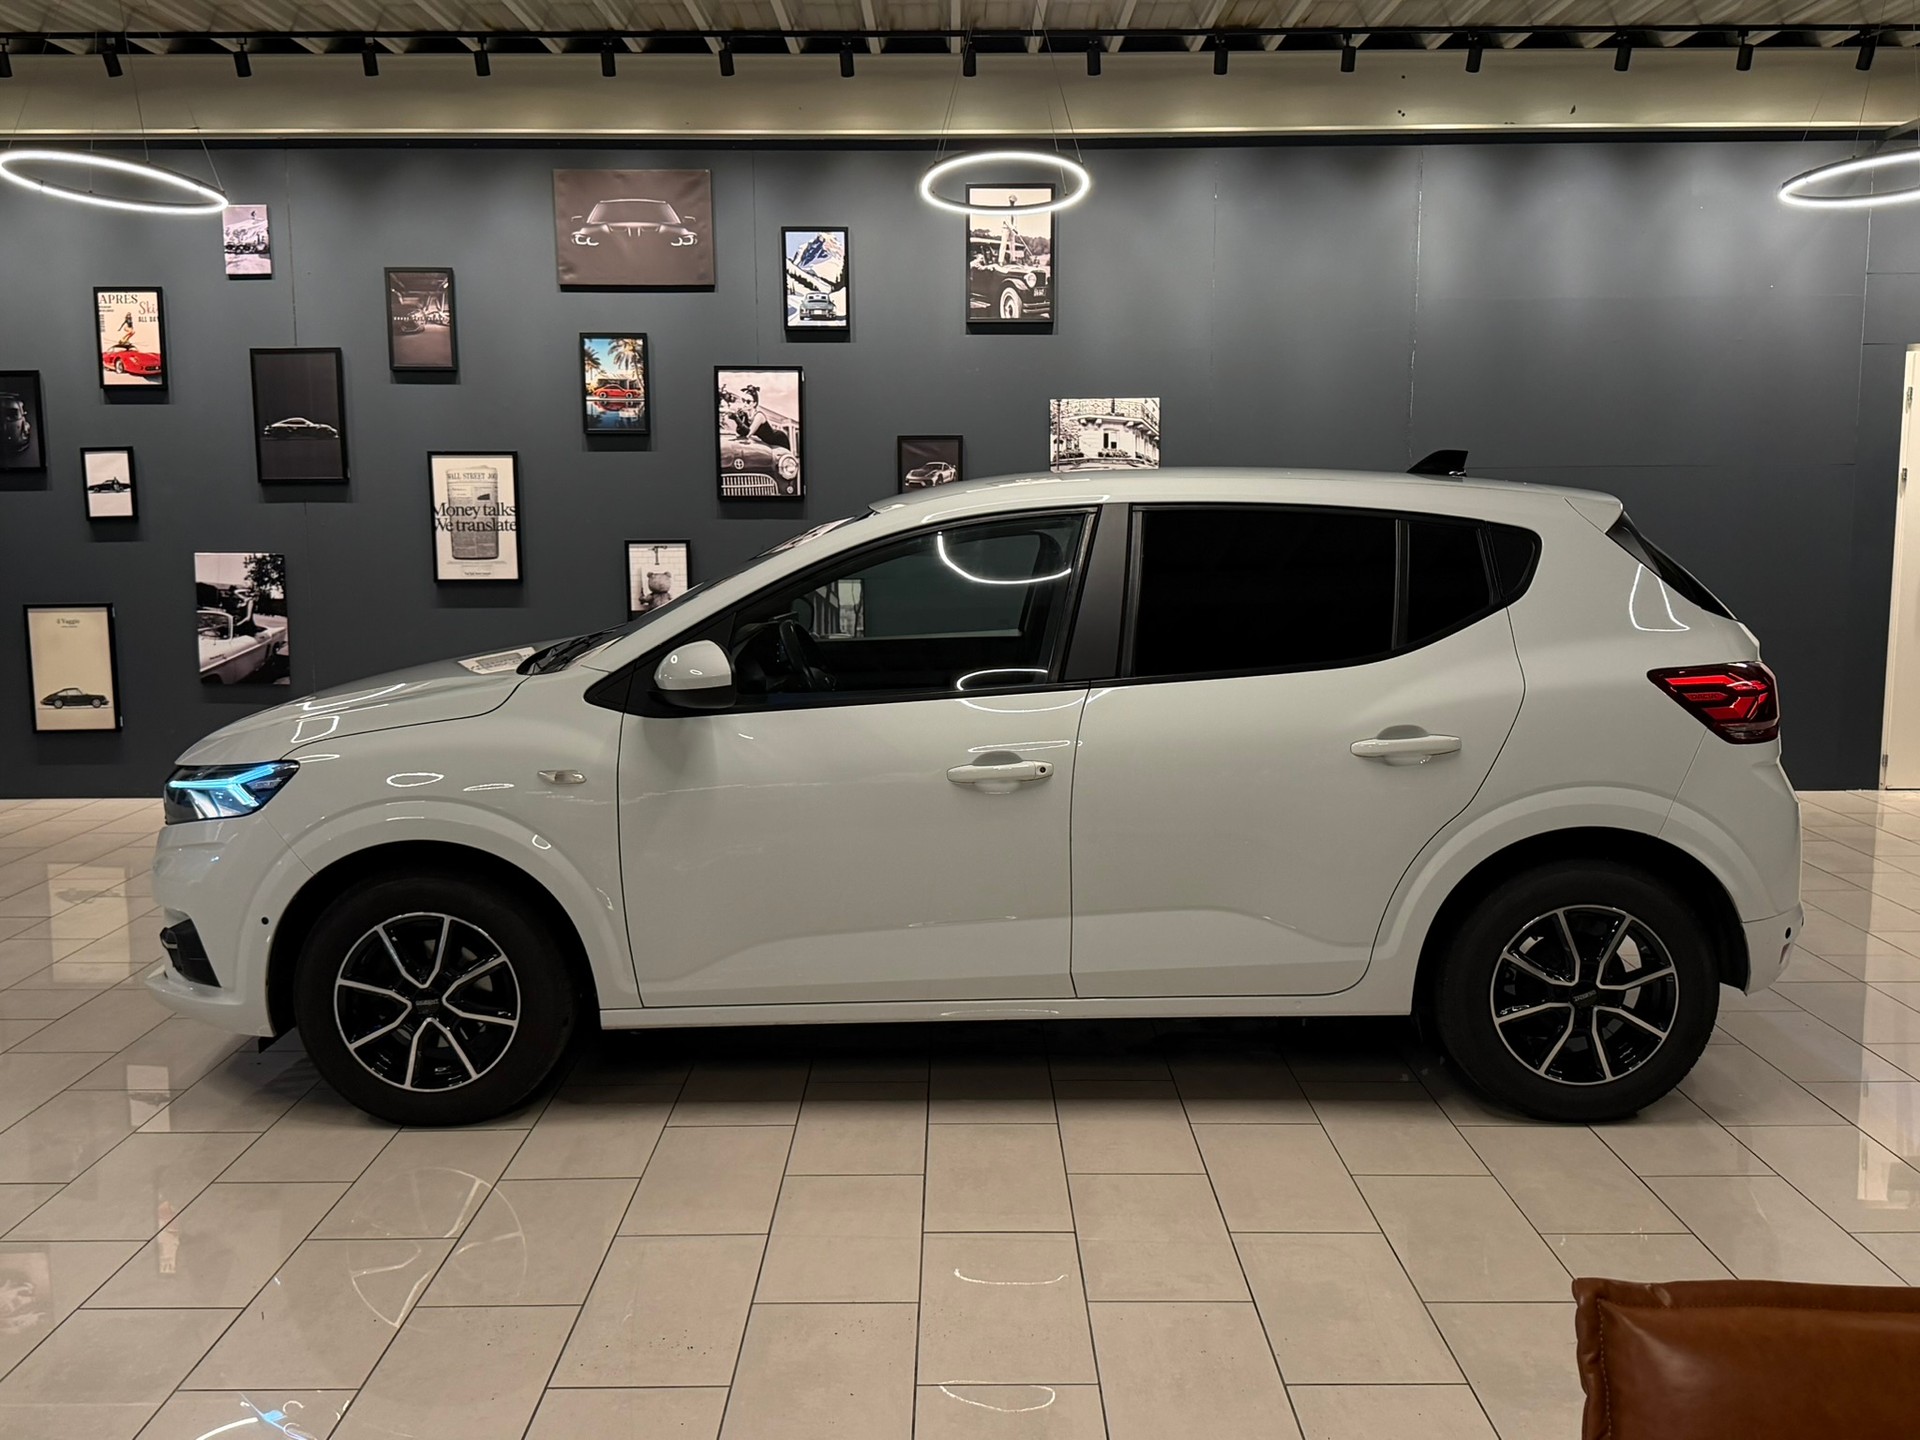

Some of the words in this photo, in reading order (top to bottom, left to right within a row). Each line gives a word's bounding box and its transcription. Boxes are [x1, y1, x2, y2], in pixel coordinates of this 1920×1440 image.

[99, 294, 138, 304] APRES
[138, 300, 156, 315] Ski
[434, 502, 481, 519] Money
[456, 517, 517, 531] translate
